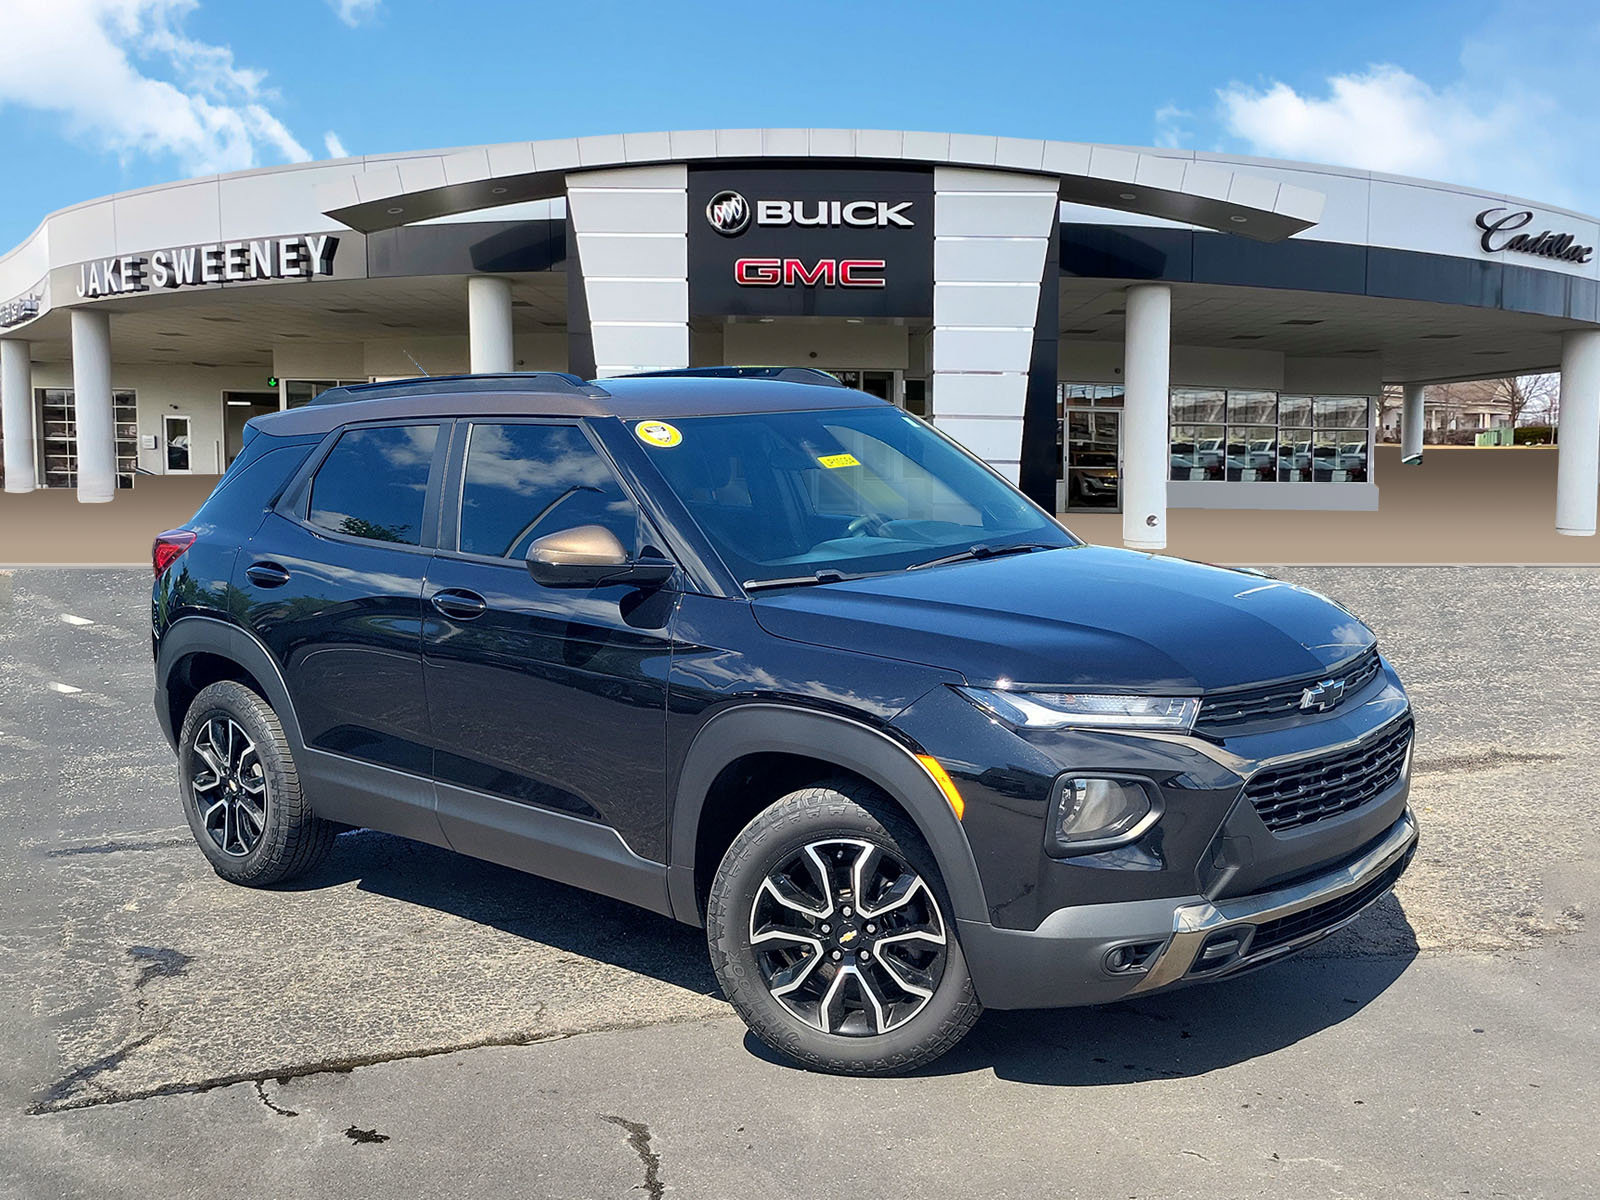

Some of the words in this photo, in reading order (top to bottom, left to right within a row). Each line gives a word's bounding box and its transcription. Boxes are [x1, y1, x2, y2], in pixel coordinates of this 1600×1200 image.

[757, 200, 914, 226] BUICK
[1475, 207, 1593, 264] Cadillac
[76, 255, 142, 298] JAKE
[151, 234, 336, 288] SWEENEY
[735, 258, 886, 286] GMC
